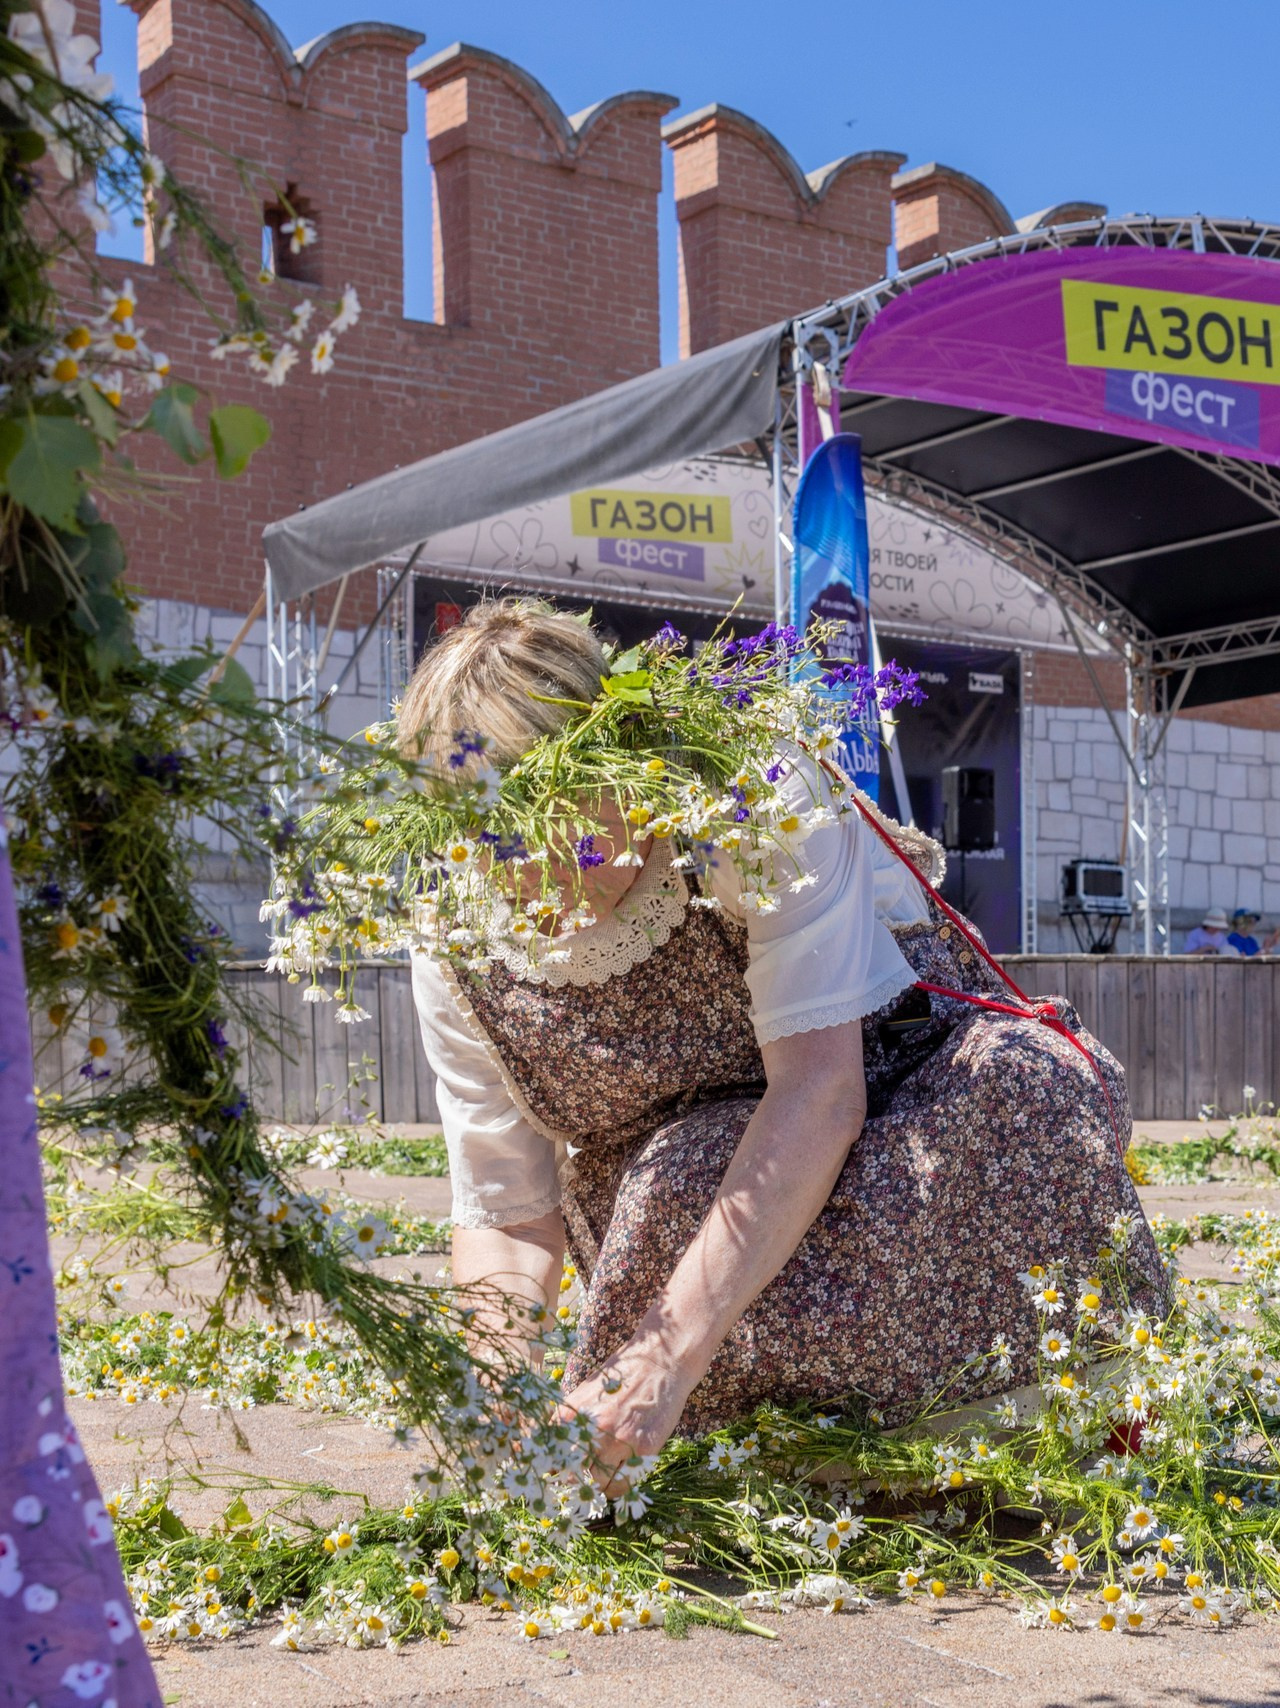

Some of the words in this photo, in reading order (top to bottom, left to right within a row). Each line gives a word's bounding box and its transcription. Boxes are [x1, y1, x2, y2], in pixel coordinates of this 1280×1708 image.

[1093, 298, 1274, 369] ГАЗОН
[1130, 371, 1236, 428] фест
[589, 497, 714, 535] ГАЗОН
[615, 538, 689, 571] фест
[885, 548, 938, 573] ТВОЕЙ
[869, 571, 915, 594] ОСТИ
